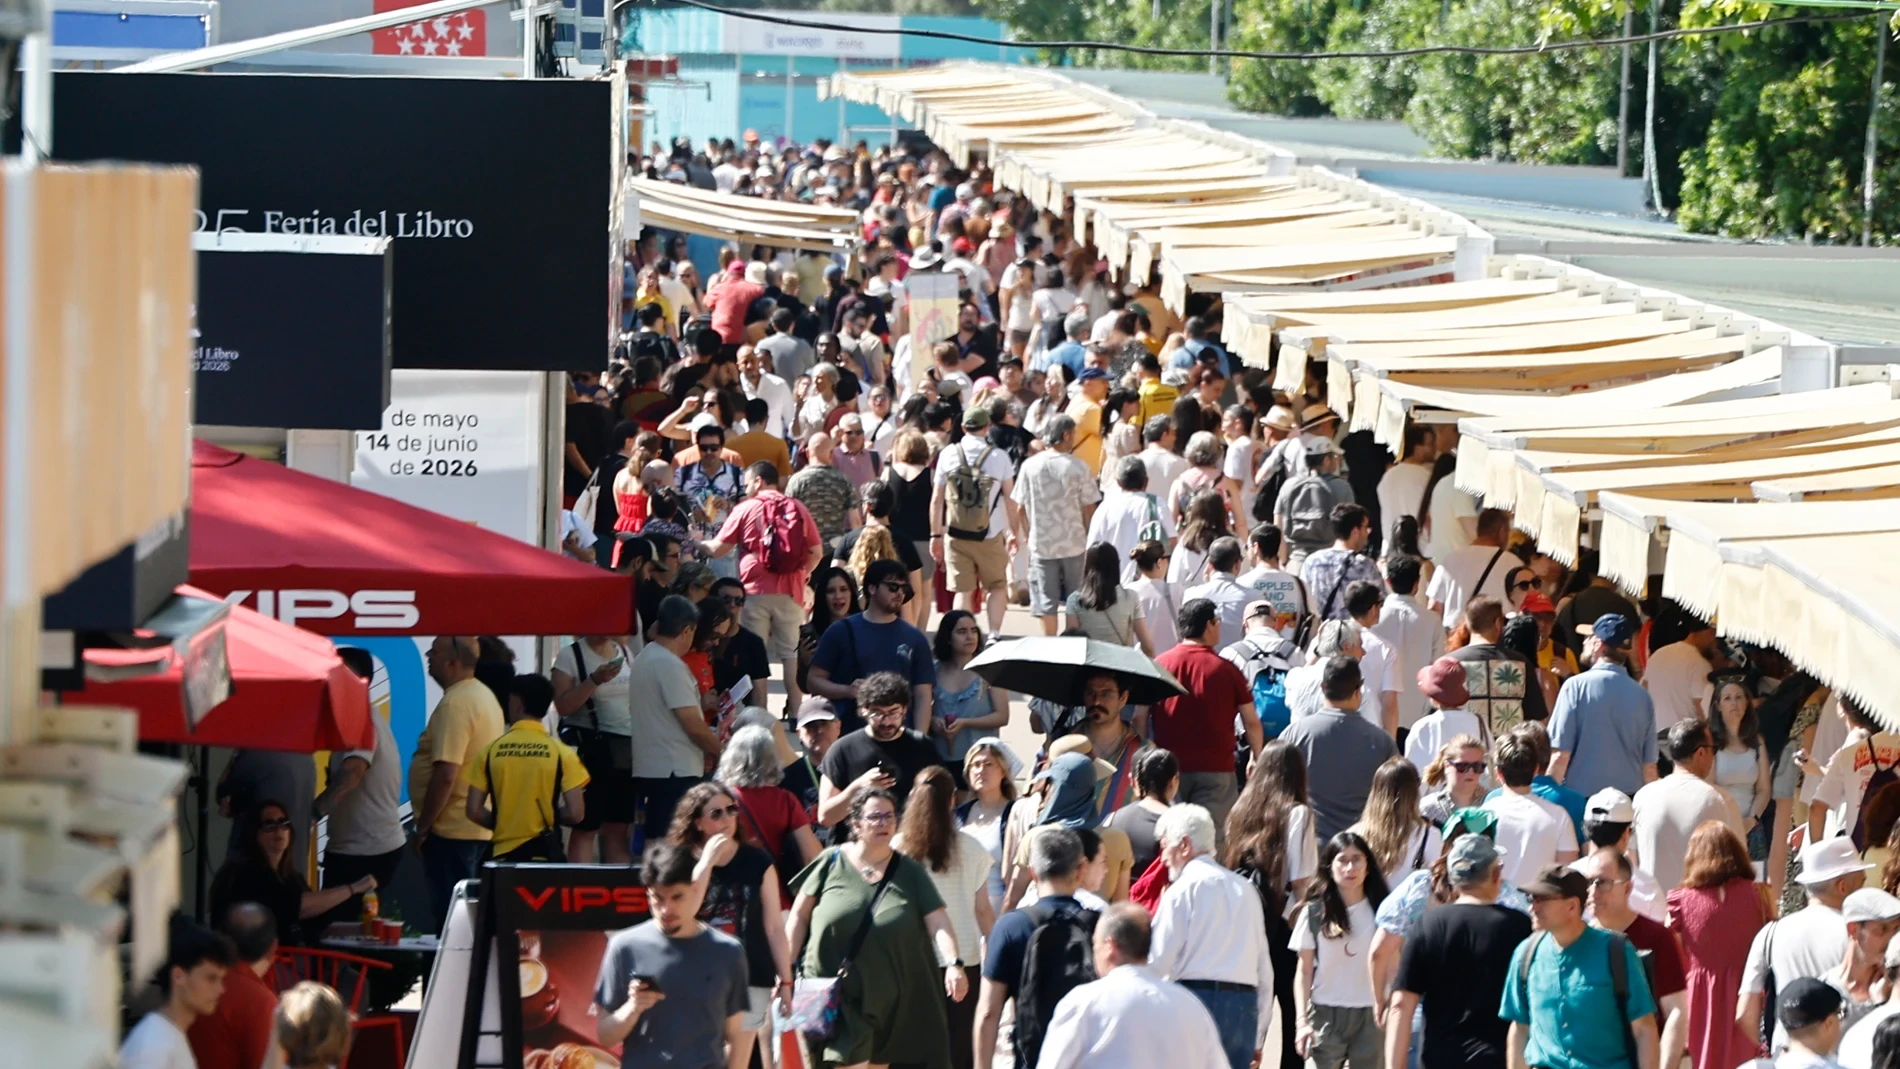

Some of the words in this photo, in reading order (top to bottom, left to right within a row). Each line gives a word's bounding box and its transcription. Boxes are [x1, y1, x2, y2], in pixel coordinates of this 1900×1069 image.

[263, 209, 336, 235] Feria
[344, 209, 388, 237] del
[396, 211, 474, 238] Libro
[391, 410, 417, 427] de
[423, 413, 479, 432] mayo
[366, 434, 390, 451] 14
[397, 434, 422, 452] de
[427, 434, 478, 455] junio
[390, 460, 415, 475] de
[421, 459, 478, 477] 2026
[1254, 581, 1294, 591] APPLES
[495, 750, 551, 759] AUXILIARES
[515, 886, 649, 913] VIPS
